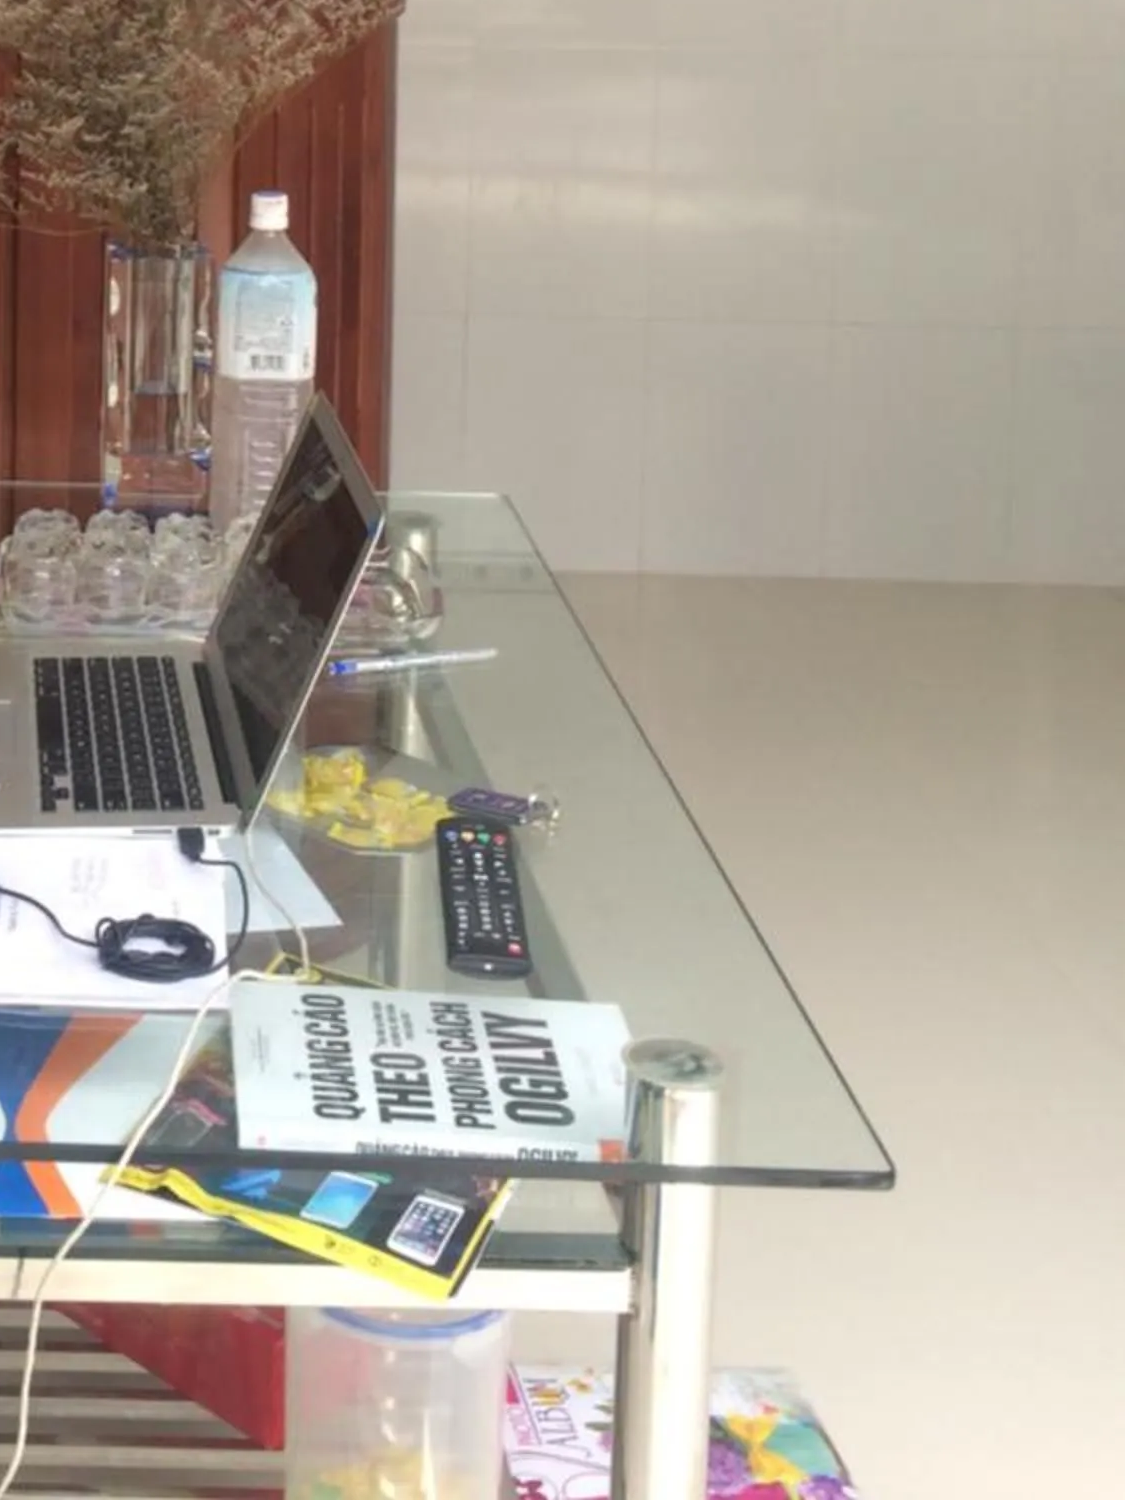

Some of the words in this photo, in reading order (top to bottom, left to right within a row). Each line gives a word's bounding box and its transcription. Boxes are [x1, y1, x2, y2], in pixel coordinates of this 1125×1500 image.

[292, 993, 350, 1038] CÁO
[427, 1001, 480, 1052] CÁCH
[293, 1038, 366, 1121] QUẢNG
[369, 1052, 437, 1124] THEO
[441, 1056, 497, 1130] PHONG
[480, 1010, 576, 1128] OGILVY
